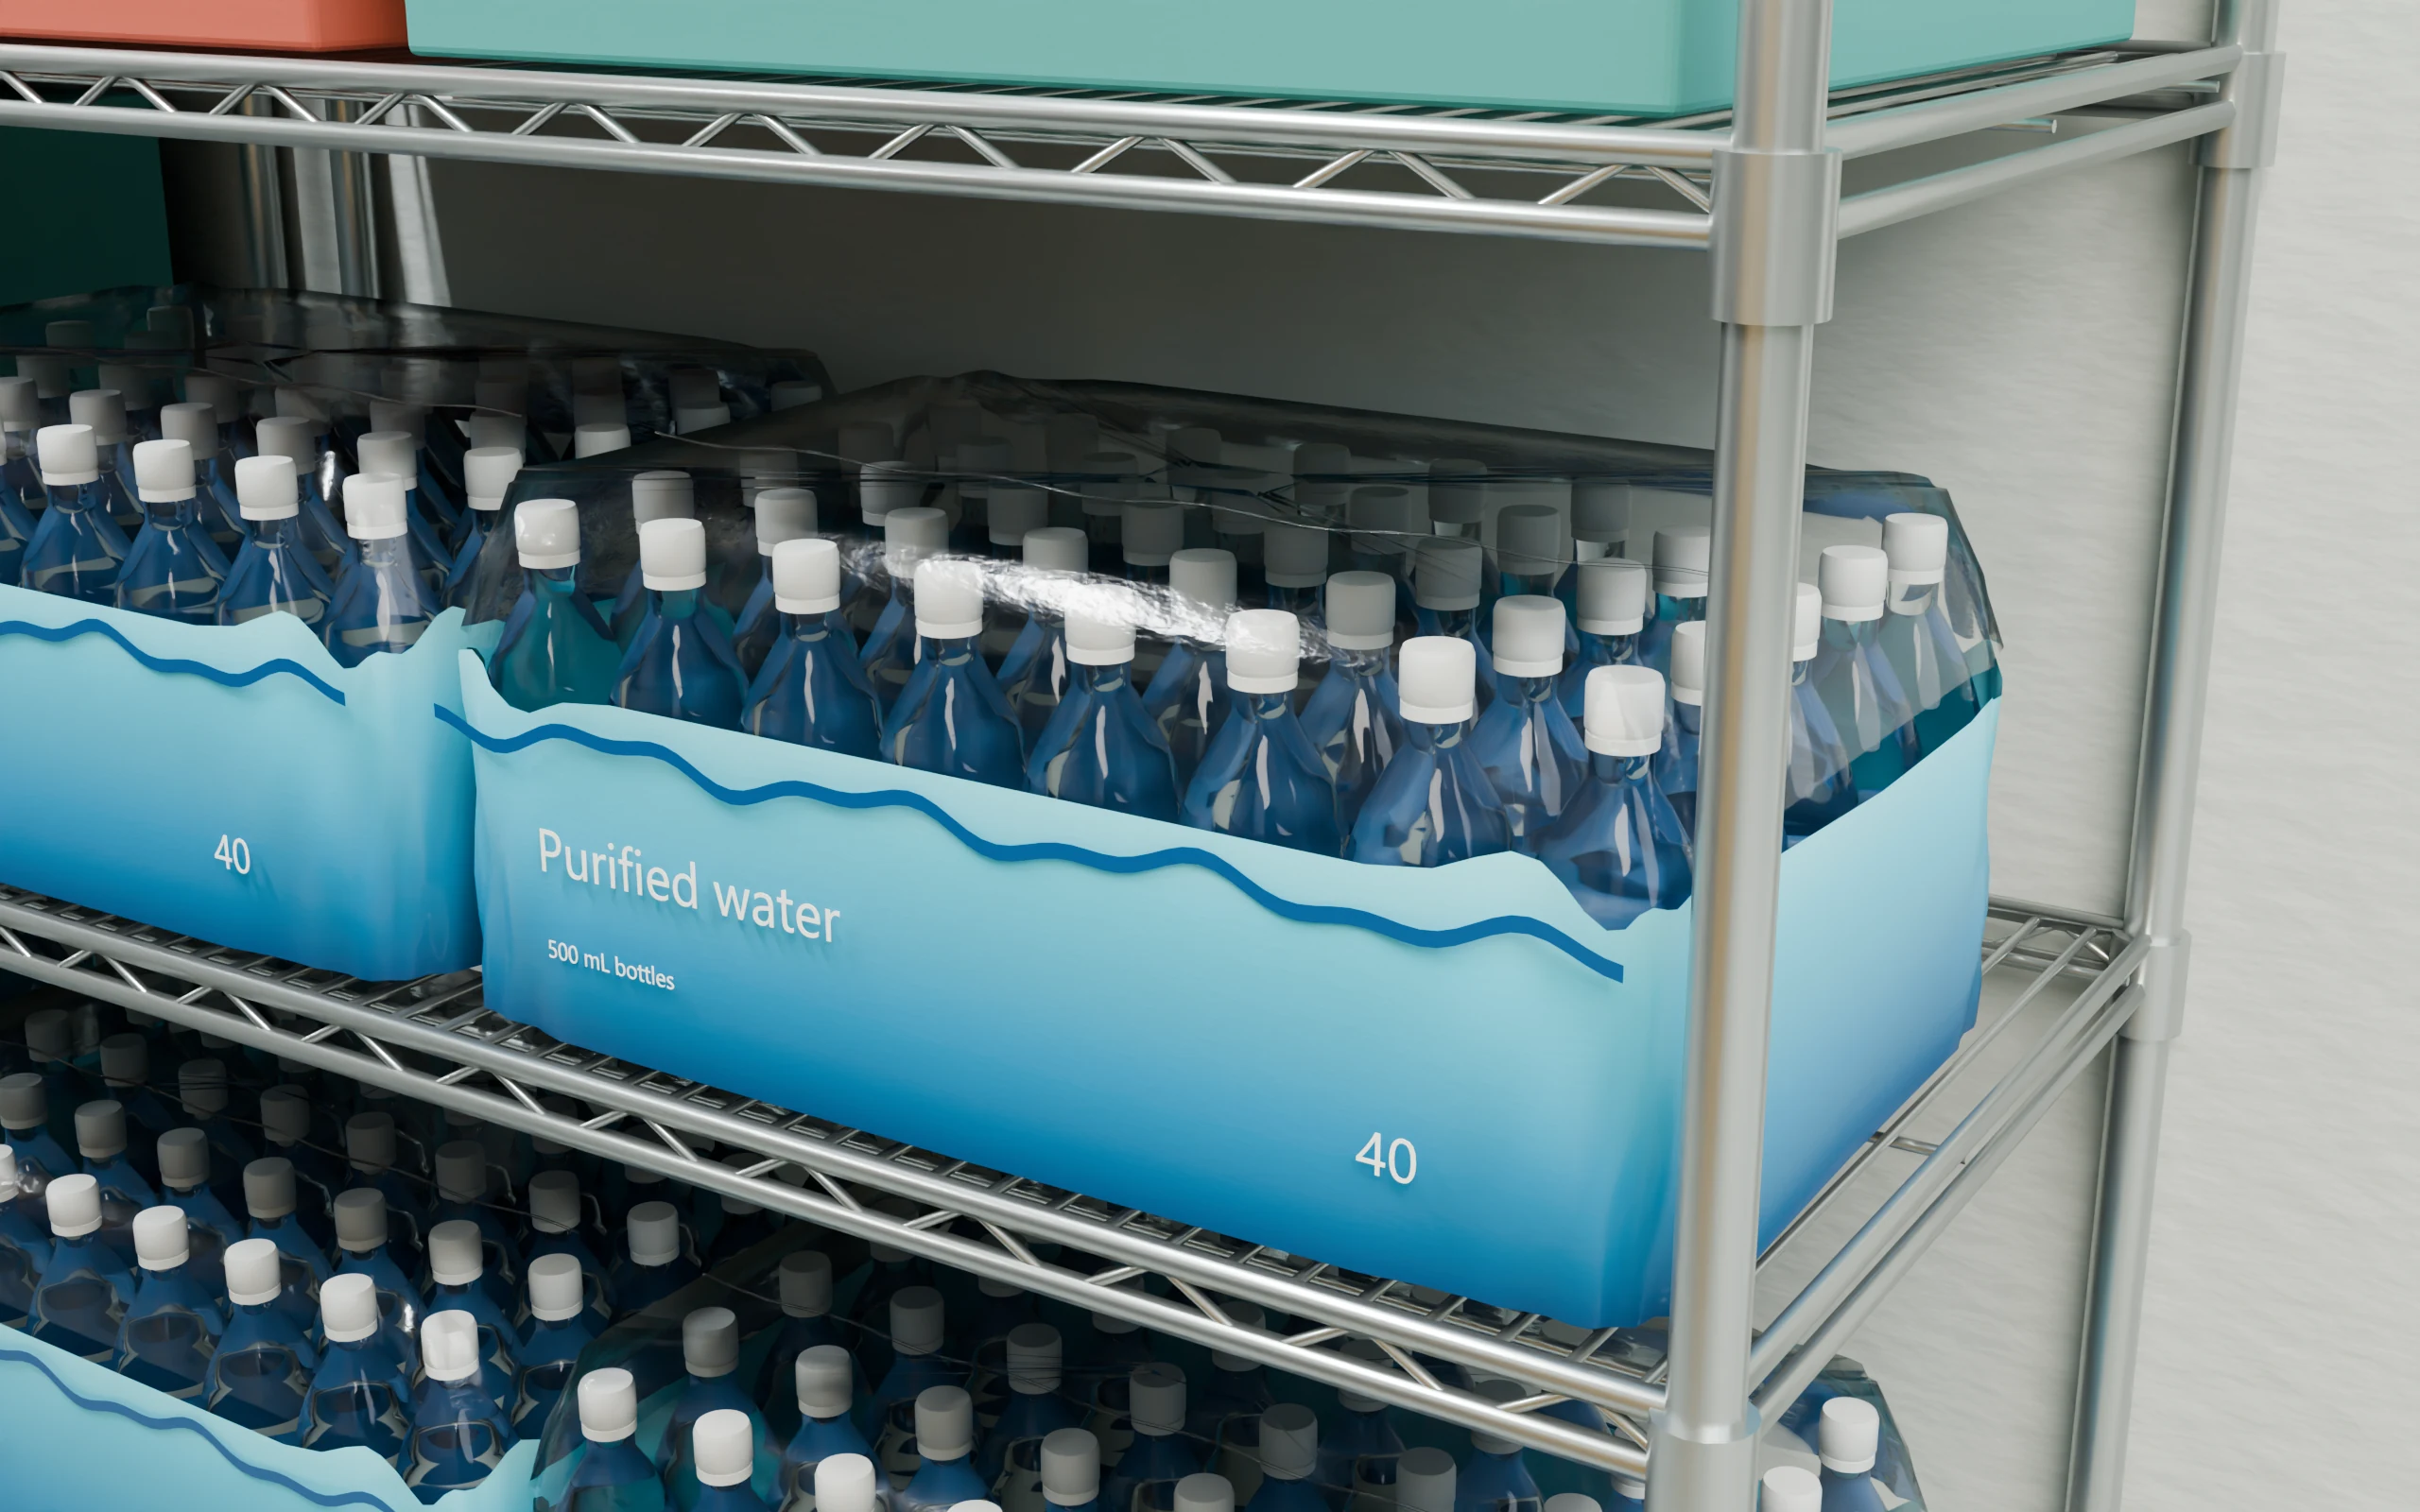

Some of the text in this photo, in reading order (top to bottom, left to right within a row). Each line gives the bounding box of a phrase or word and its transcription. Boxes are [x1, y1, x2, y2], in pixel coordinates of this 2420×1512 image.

[214, 833, 251, 874] 40
[539, 828, 840, 942] Purified water
[548, 939, 675, 990] 500 mL bottles
[1355, 1131, 1417, 1184] 40
